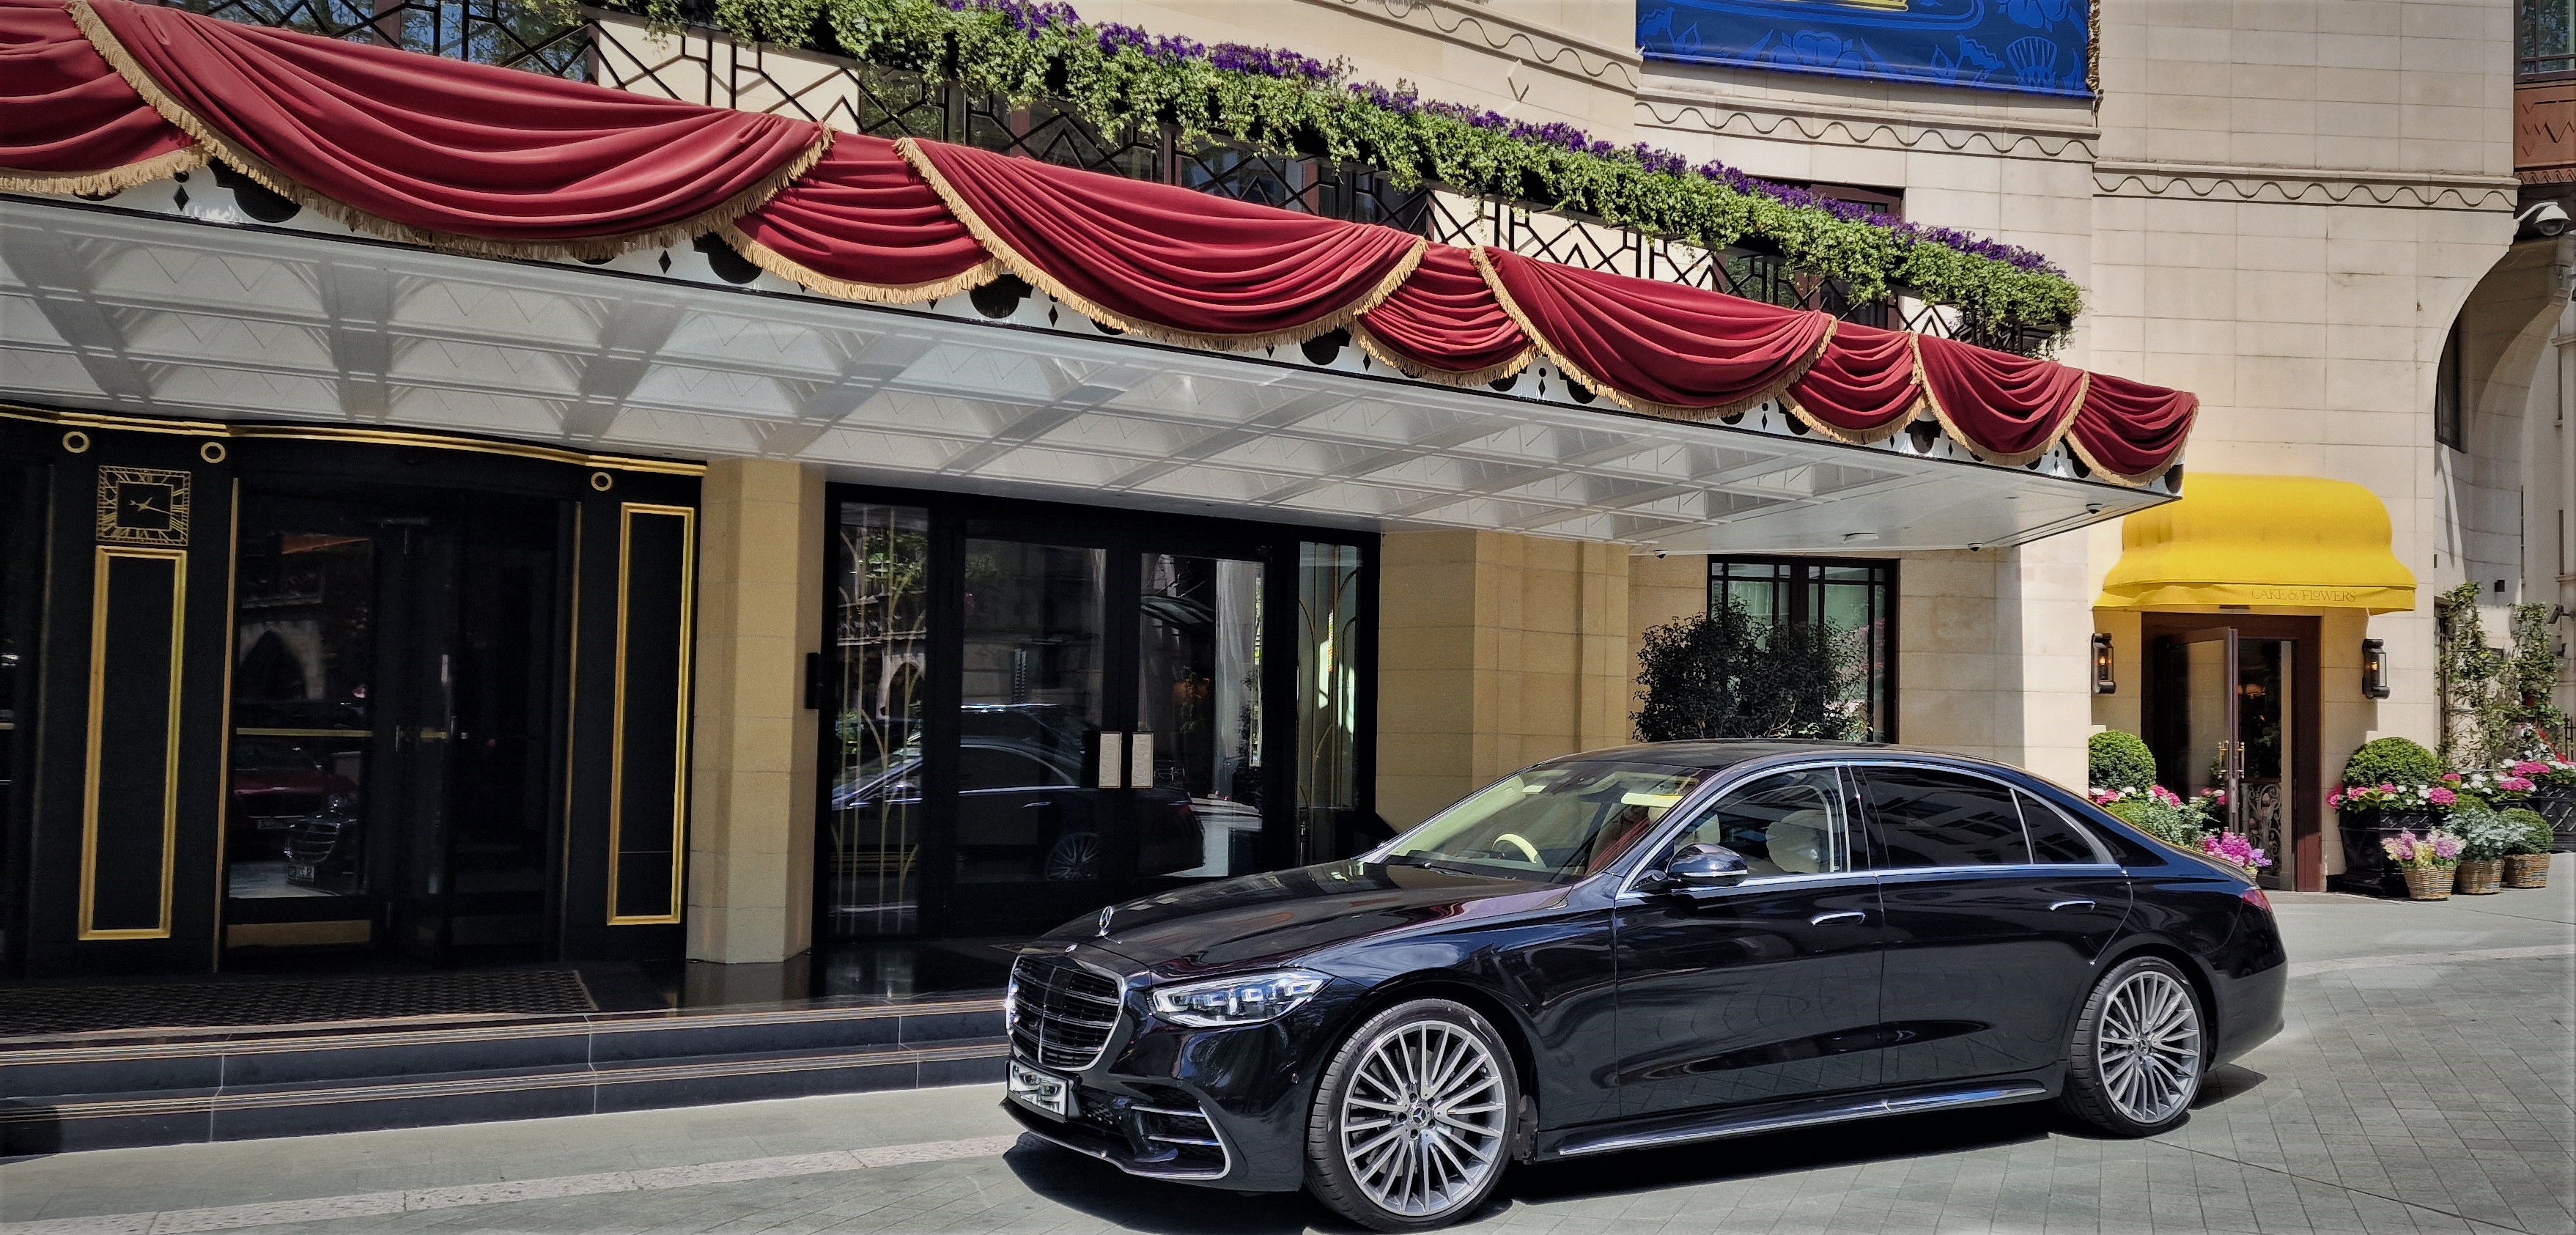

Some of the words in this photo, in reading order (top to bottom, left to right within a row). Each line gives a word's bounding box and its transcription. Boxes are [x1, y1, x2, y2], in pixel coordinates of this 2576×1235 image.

[2251, 588, 2287, 600] CAKE
[2288, 589, 2299, 601] &
[2299, 589, 2357, 602] FLOWERS
